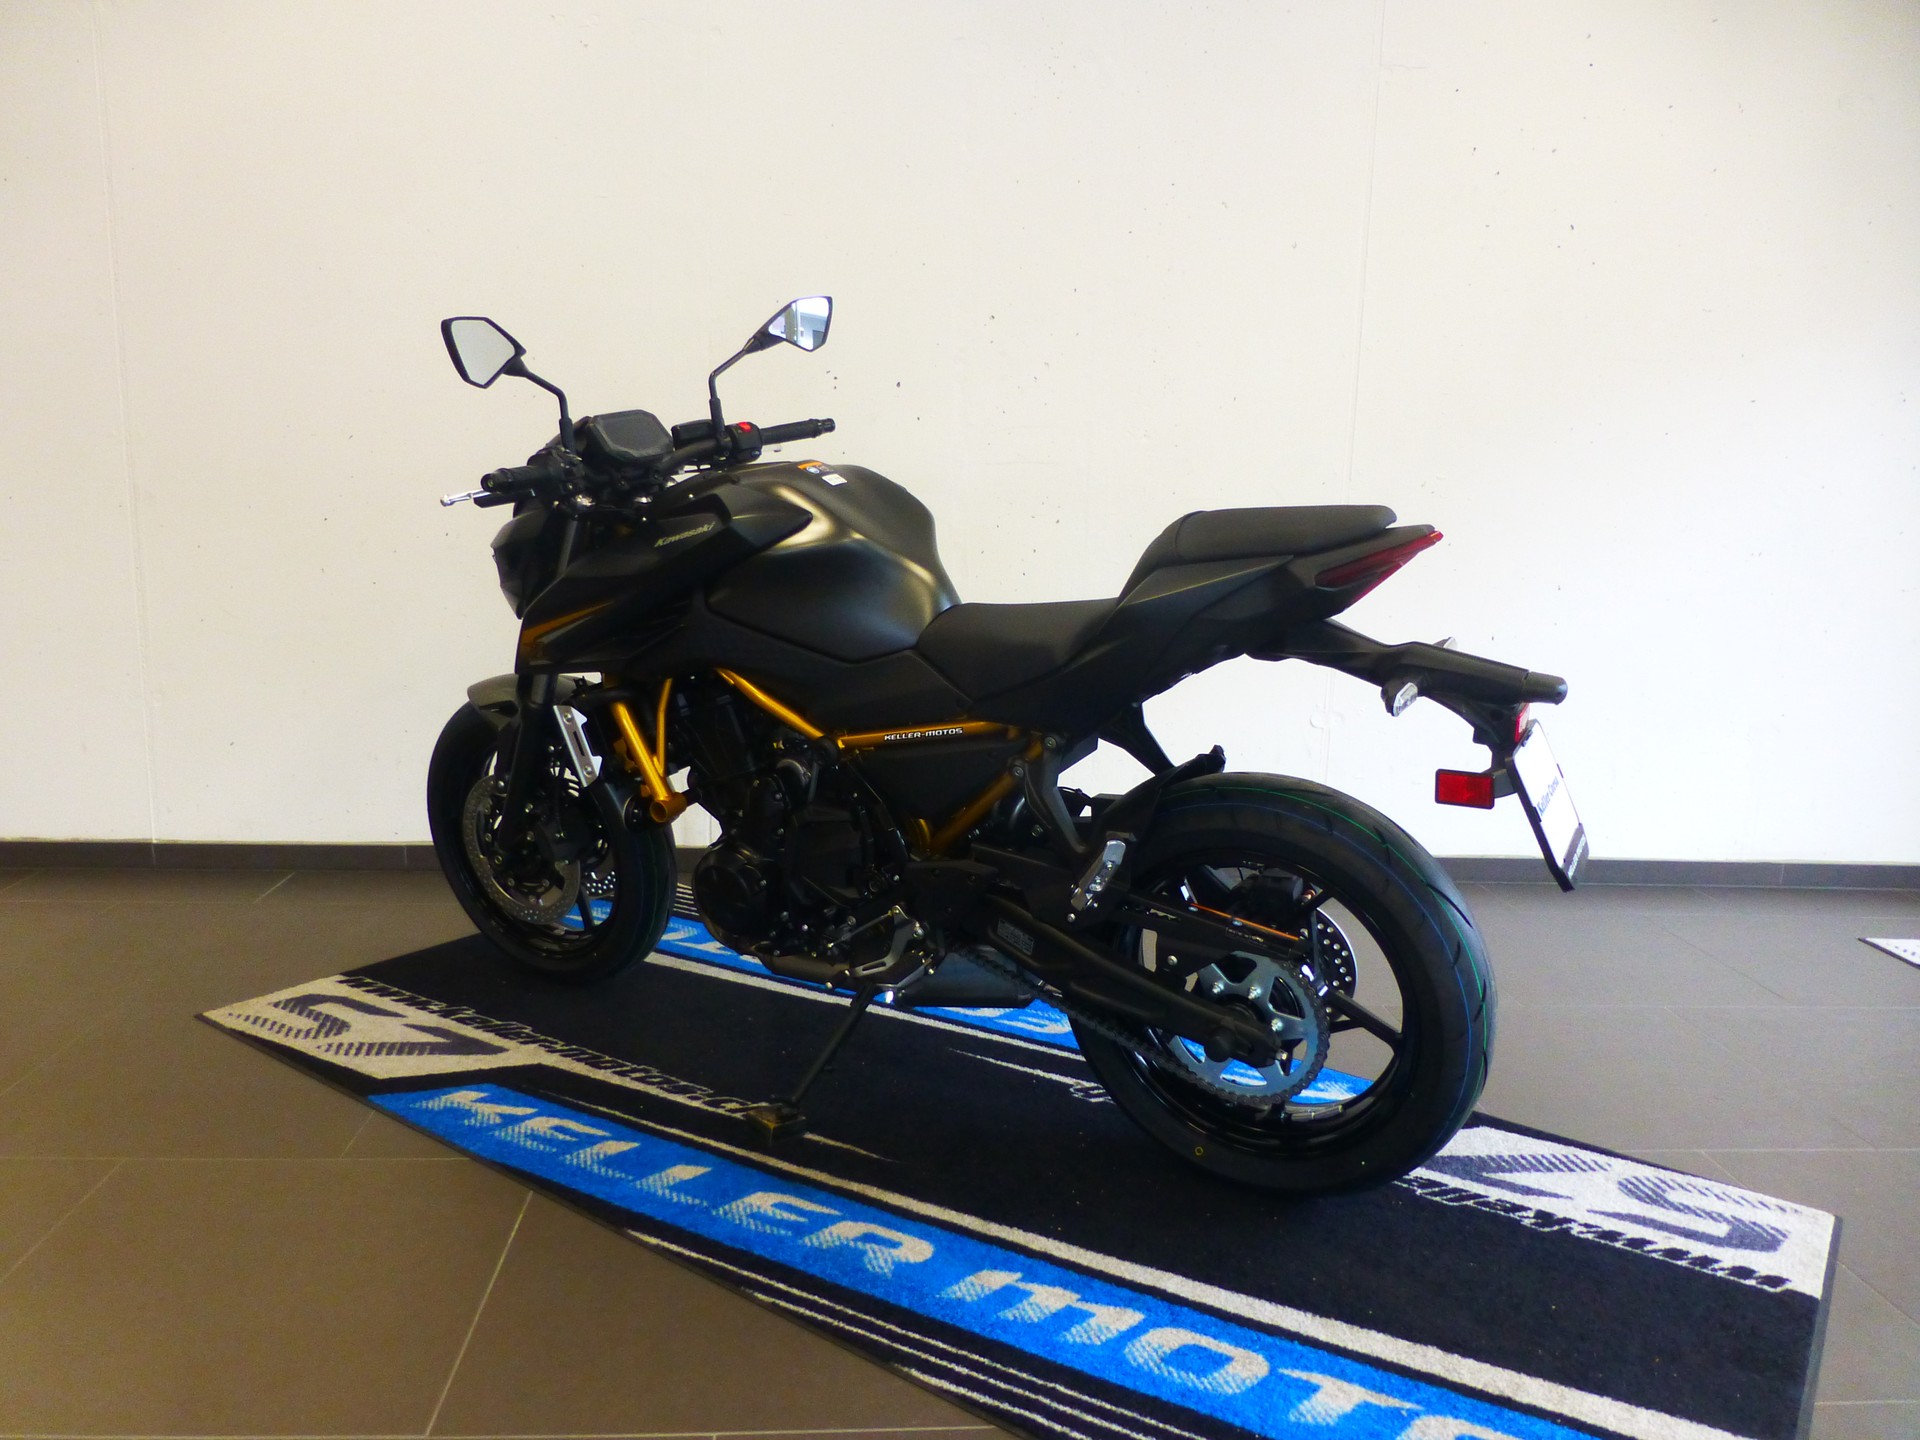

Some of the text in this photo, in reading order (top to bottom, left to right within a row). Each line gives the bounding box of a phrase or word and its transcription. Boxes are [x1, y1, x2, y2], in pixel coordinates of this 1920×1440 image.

[654, 521, 716, 548] Kawasaki
[884, 727, 963, 741] KELLER-MOTOS
[408, 1089, 936, 1279] KELLER
